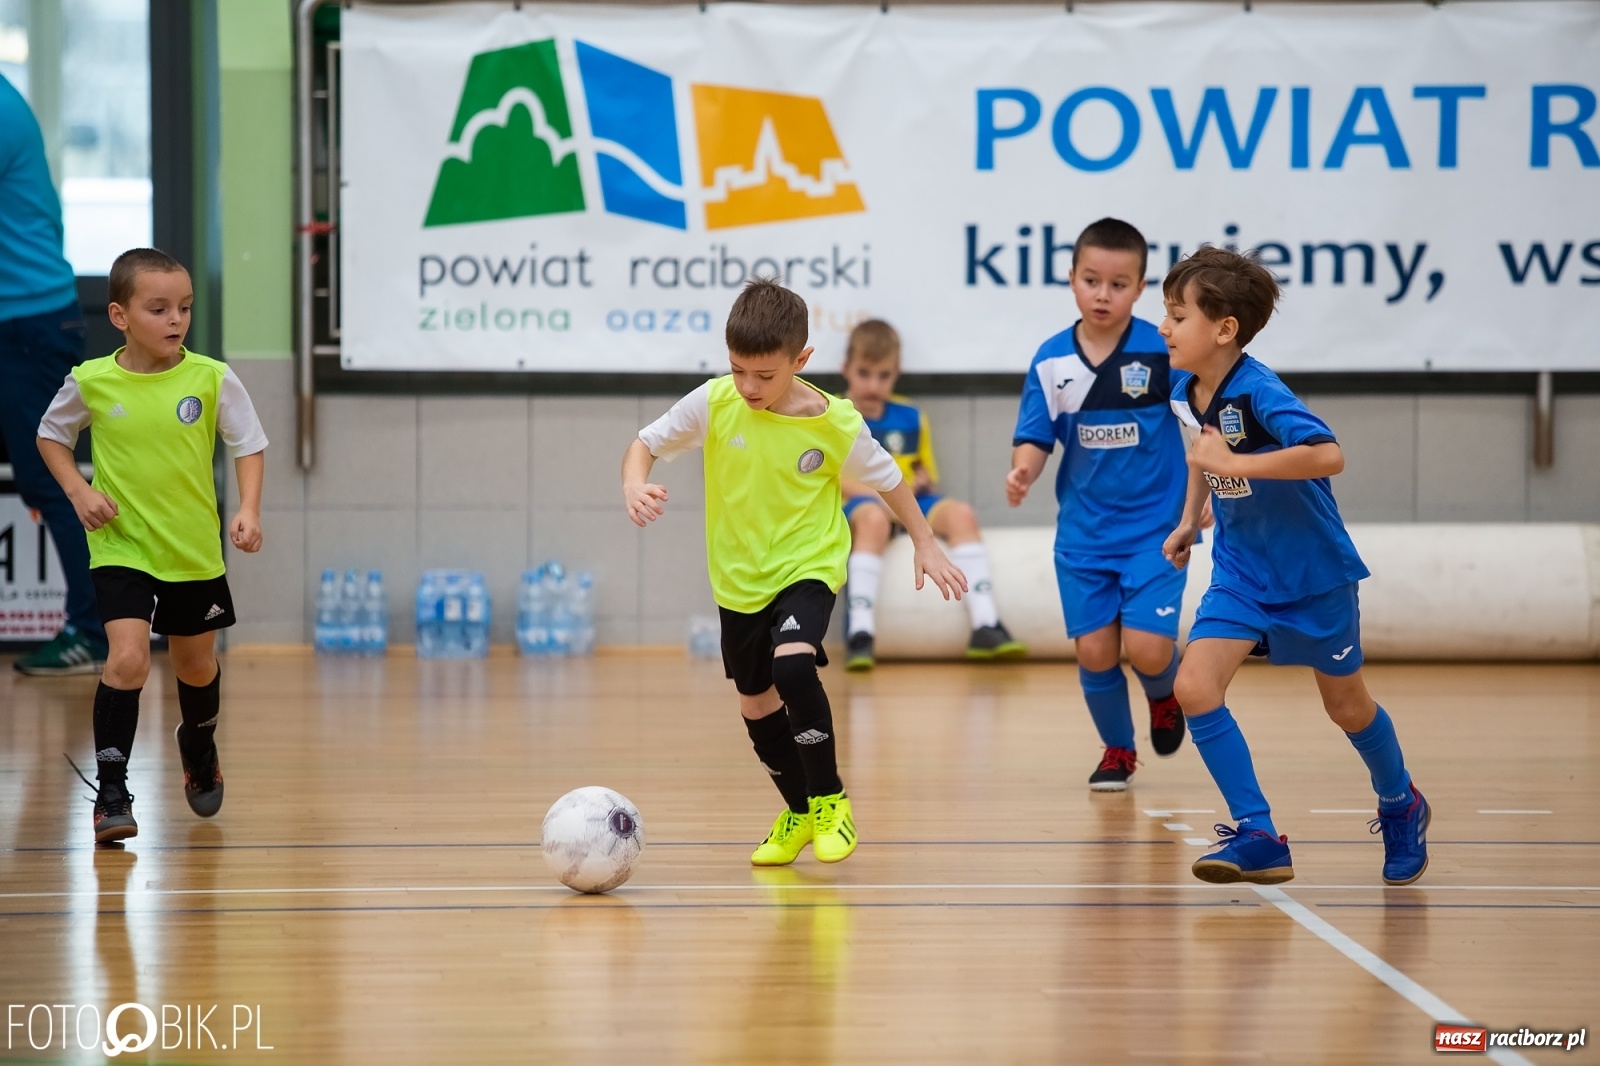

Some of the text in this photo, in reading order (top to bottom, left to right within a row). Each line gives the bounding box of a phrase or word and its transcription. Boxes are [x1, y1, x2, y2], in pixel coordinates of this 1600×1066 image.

[976, 84, 1487, 172] POWIAT
[419, 243, 871, 297] powiat raciborski
[418, 303, 711, 333] zielona oaza
[1225, 425, 1239, 433] GOL
